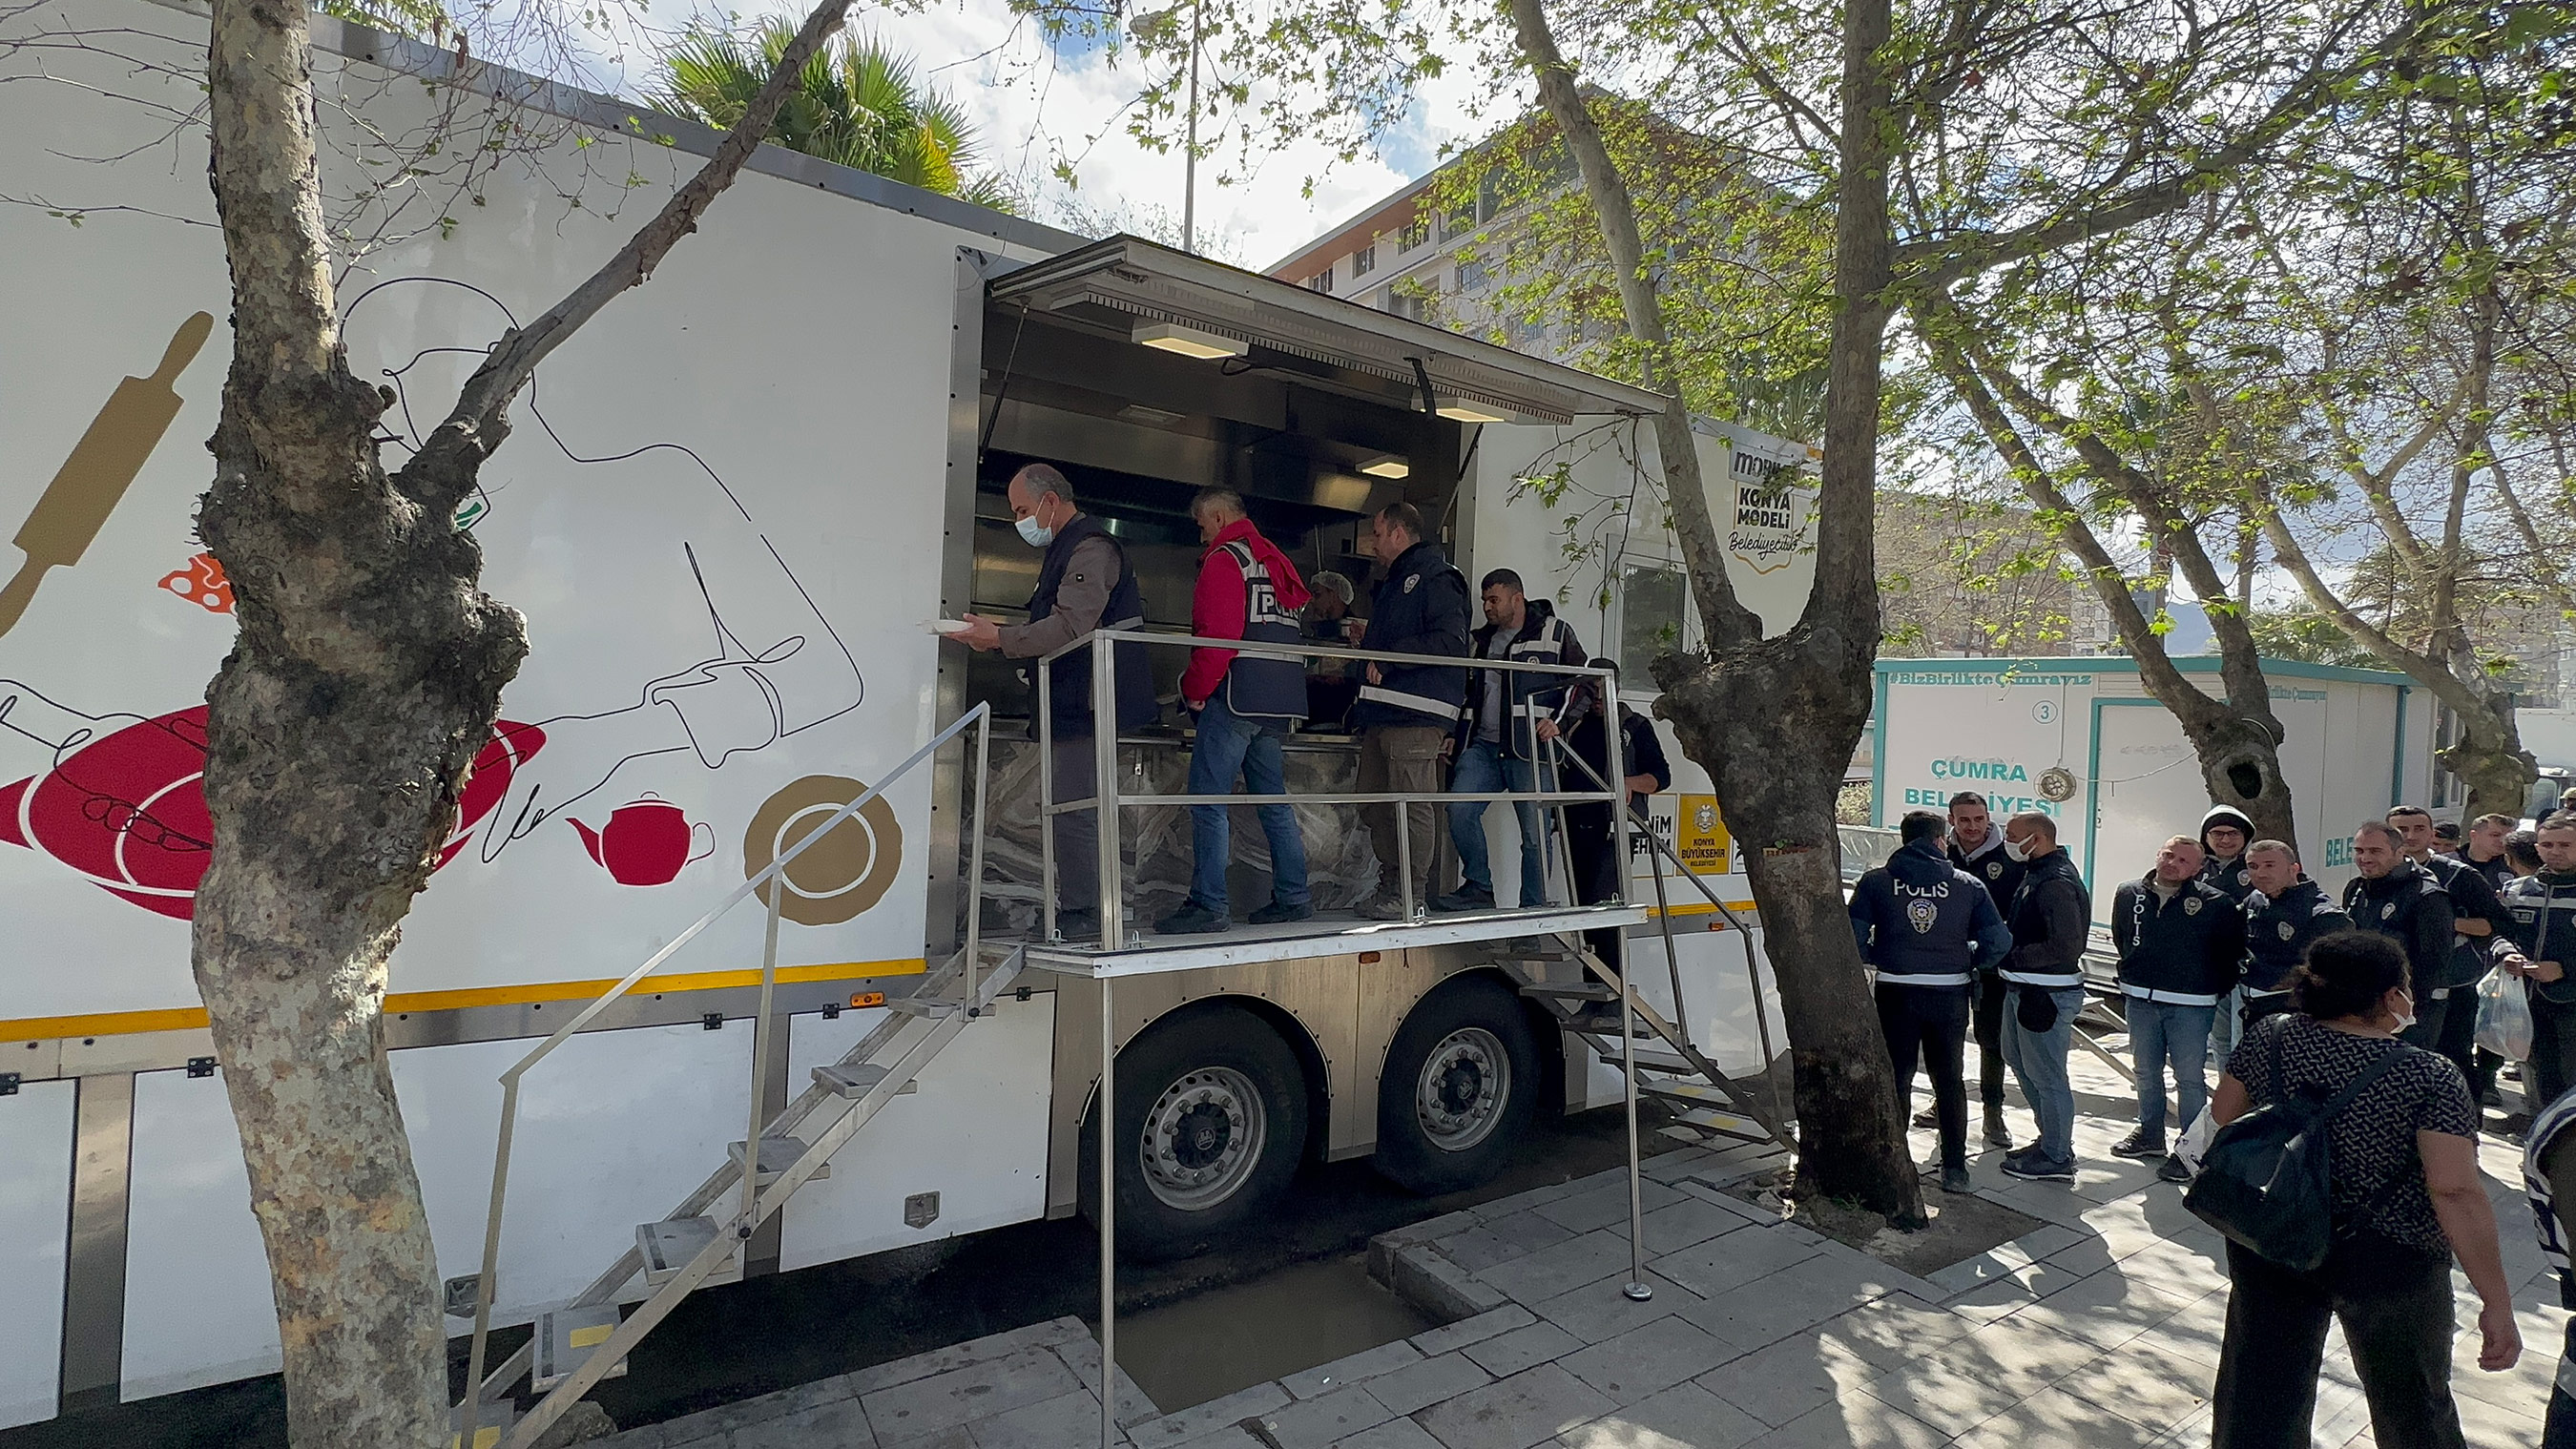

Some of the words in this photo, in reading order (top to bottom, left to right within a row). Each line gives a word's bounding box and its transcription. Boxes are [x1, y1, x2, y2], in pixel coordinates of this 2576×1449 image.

[1739, 487, 1791, 510] KONYA
[2040, 704, 2050, 720] 3
[1931, 759, 2028, 782] ÇUMRA
[1693, 838, 1715, 847] KONYA
